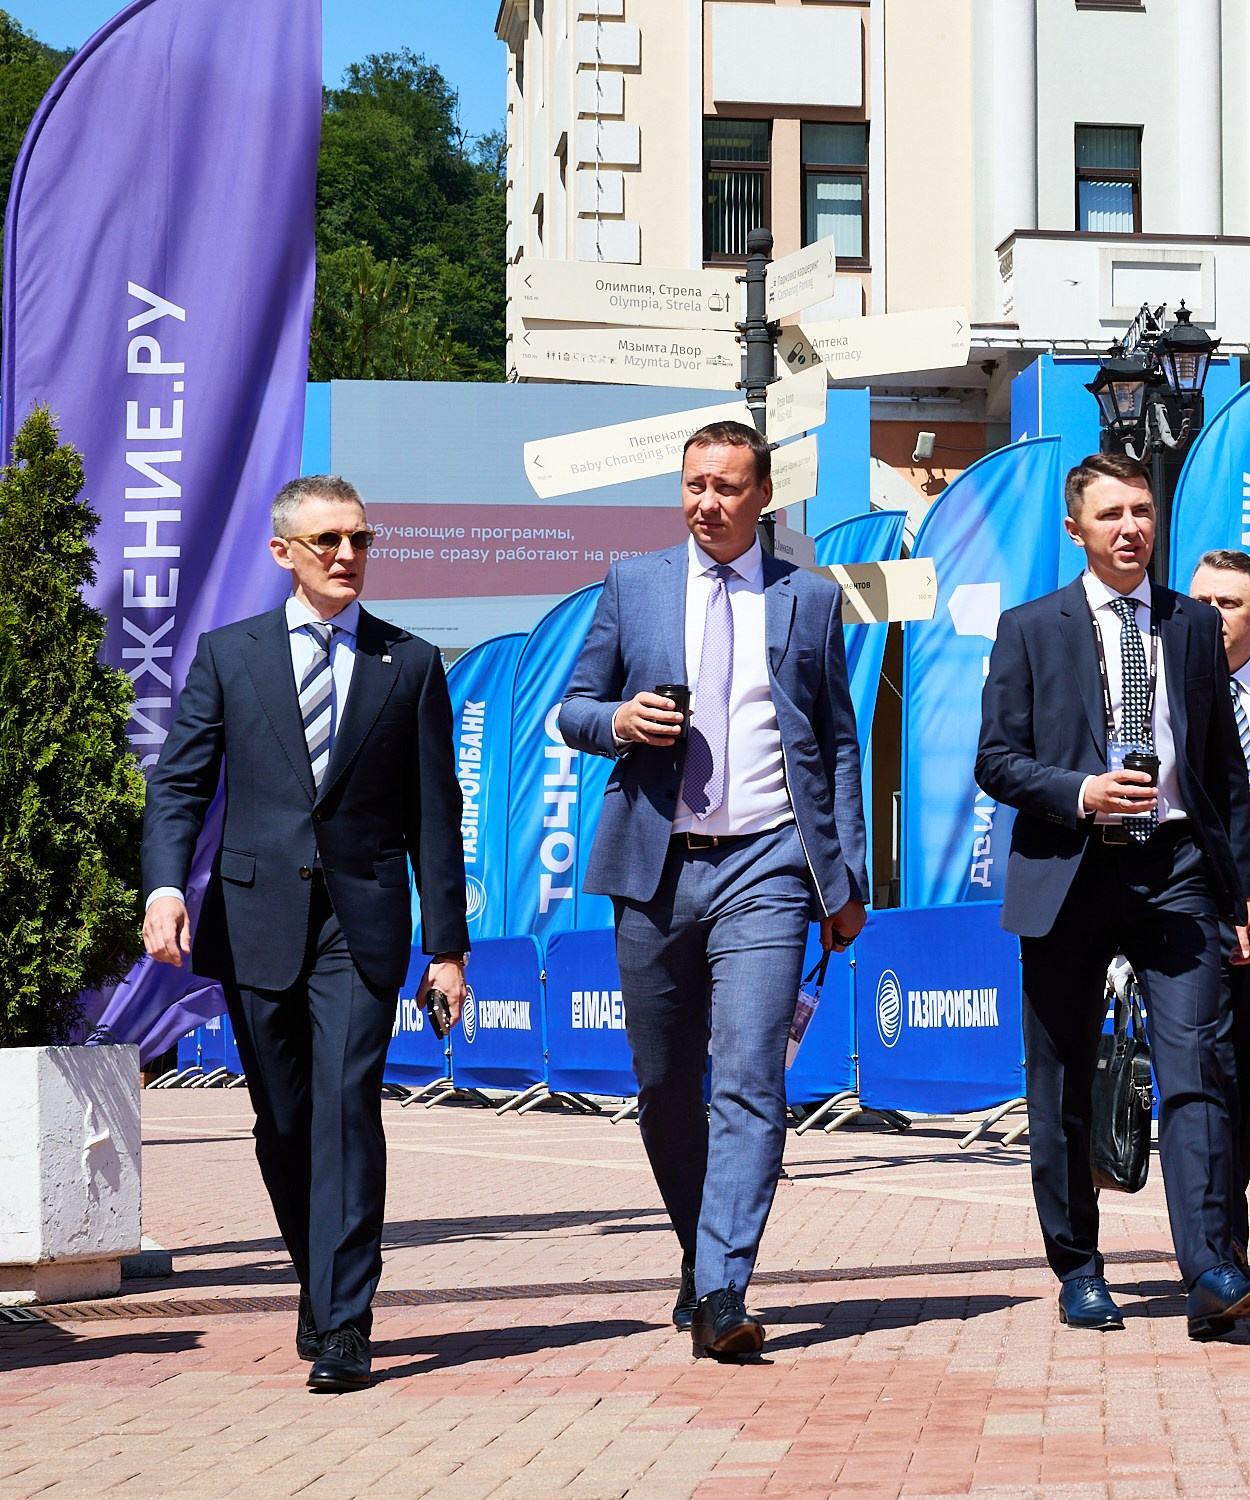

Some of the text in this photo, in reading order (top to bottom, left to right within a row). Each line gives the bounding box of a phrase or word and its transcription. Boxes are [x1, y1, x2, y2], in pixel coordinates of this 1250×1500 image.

[595, 279, 702, 298] Олимпия, Стрела
[609, 295, 702, 312] Olympia, Strela
[618, 339, 702, 358] Мзымта Двор
[811, 335, 849, 349] Аптека
[624, 354, 702, 371] Mzymta Dvor
[811, 348, 862, 364] Pharmacy
[570, 459, 602, 475] Baby
[605, 445, 664, 469] Changing
[121, 280, 187, 768] ИЖЕНИЕ.РУ
[471, 526, 575, 542] программы,
[367, 547, 435, 563] оторые
[440, 548, 490, 564] сразу
[495, 545, 579, 564] работают
[584, 550, 604, 561] на
[402, 998, 424, 1032] ПСБ
[478, 1000, 532, 1031] ГАЗПРОМБАНК
[908, 987, 999, 1029] ГАЗПРОМБАНК
